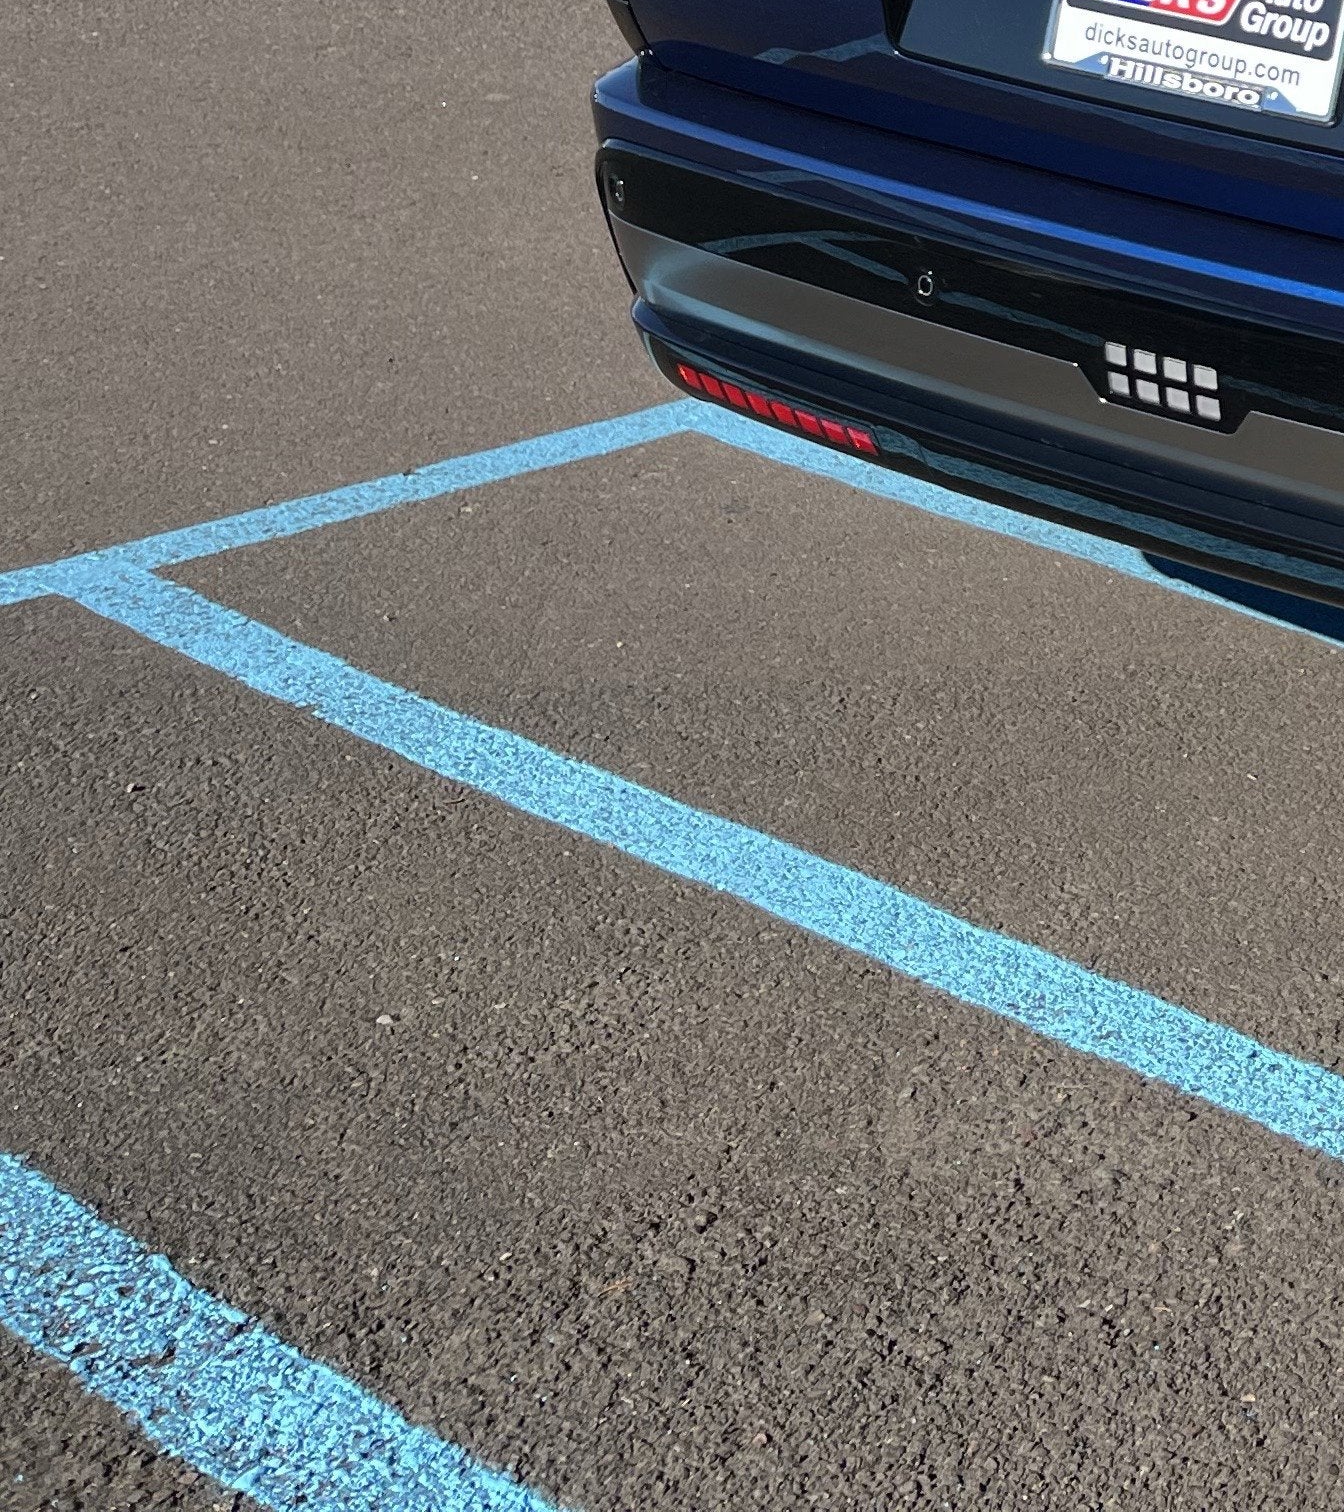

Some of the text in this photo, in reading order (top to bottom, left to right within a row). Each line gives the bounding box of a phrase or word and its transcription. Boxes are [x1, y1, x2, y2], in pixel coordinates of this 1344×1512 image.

[1240, 2, 1330, 51] Group
[1085, 22, 1301, 86] dicksautogroup.com
[1108, 57, 1261, 106] Hillsboro
